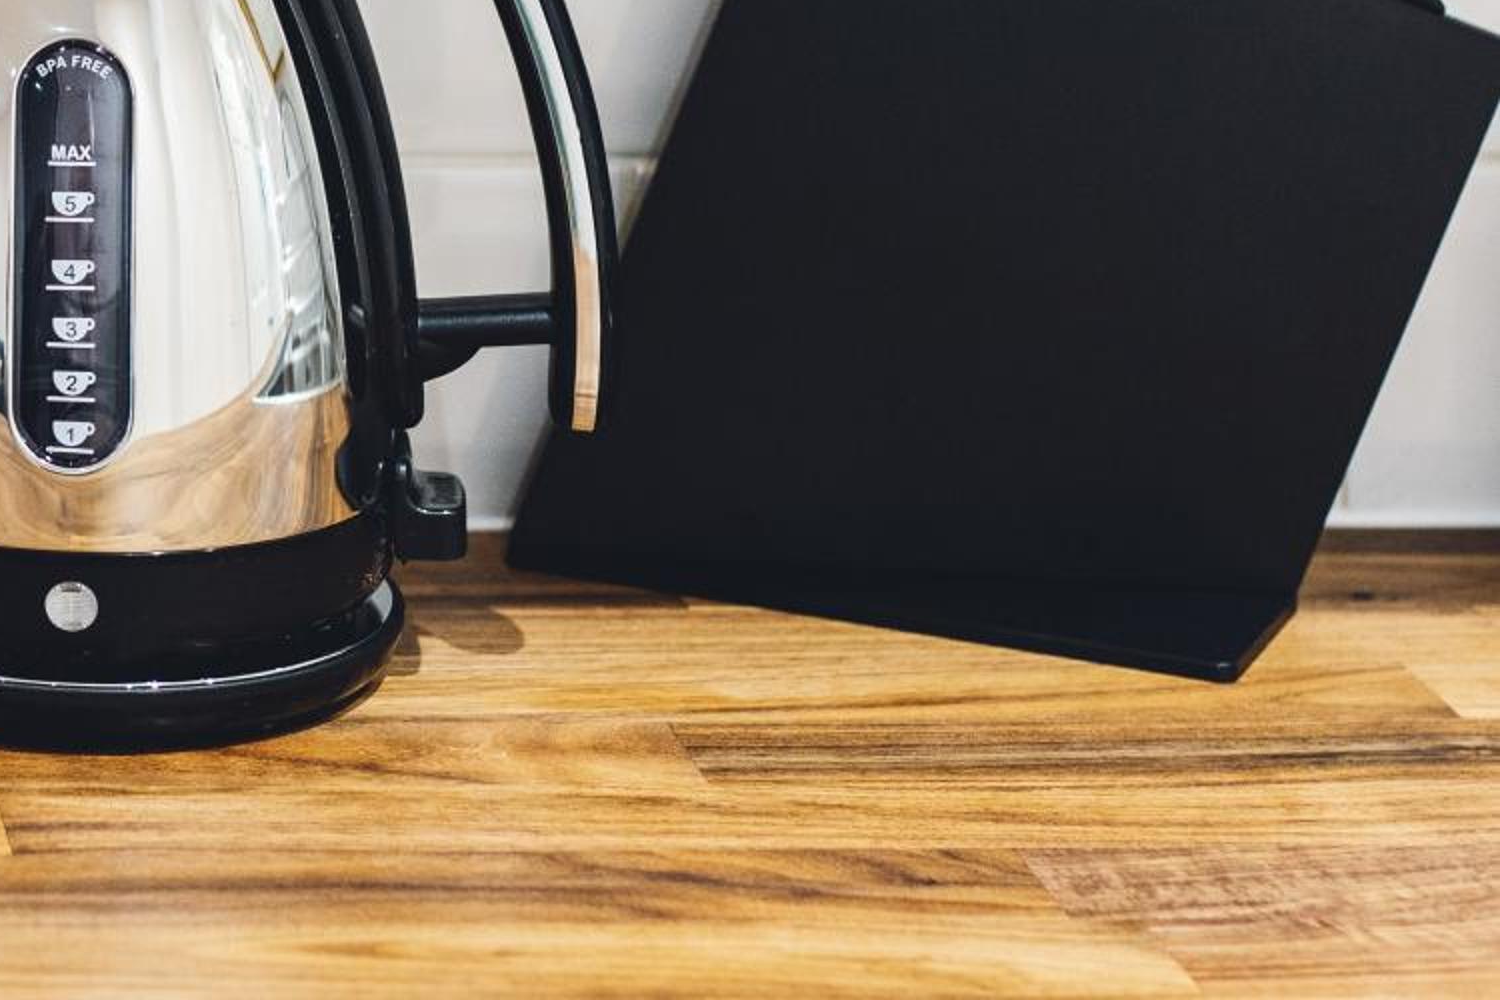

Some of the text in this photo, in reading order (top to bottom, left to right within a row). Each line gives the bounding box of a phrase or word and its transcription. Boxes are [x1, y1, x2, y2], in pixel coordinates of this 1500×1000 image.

[35, 55, 114, 79] BPA FREE
[51, 144, 92, 161] MAX
[65, 195, 77, 213] 5
[63, 264, 77, 281] 4
[65, 321, 77, 339] 3
[65, 375, 77, 393] 2
